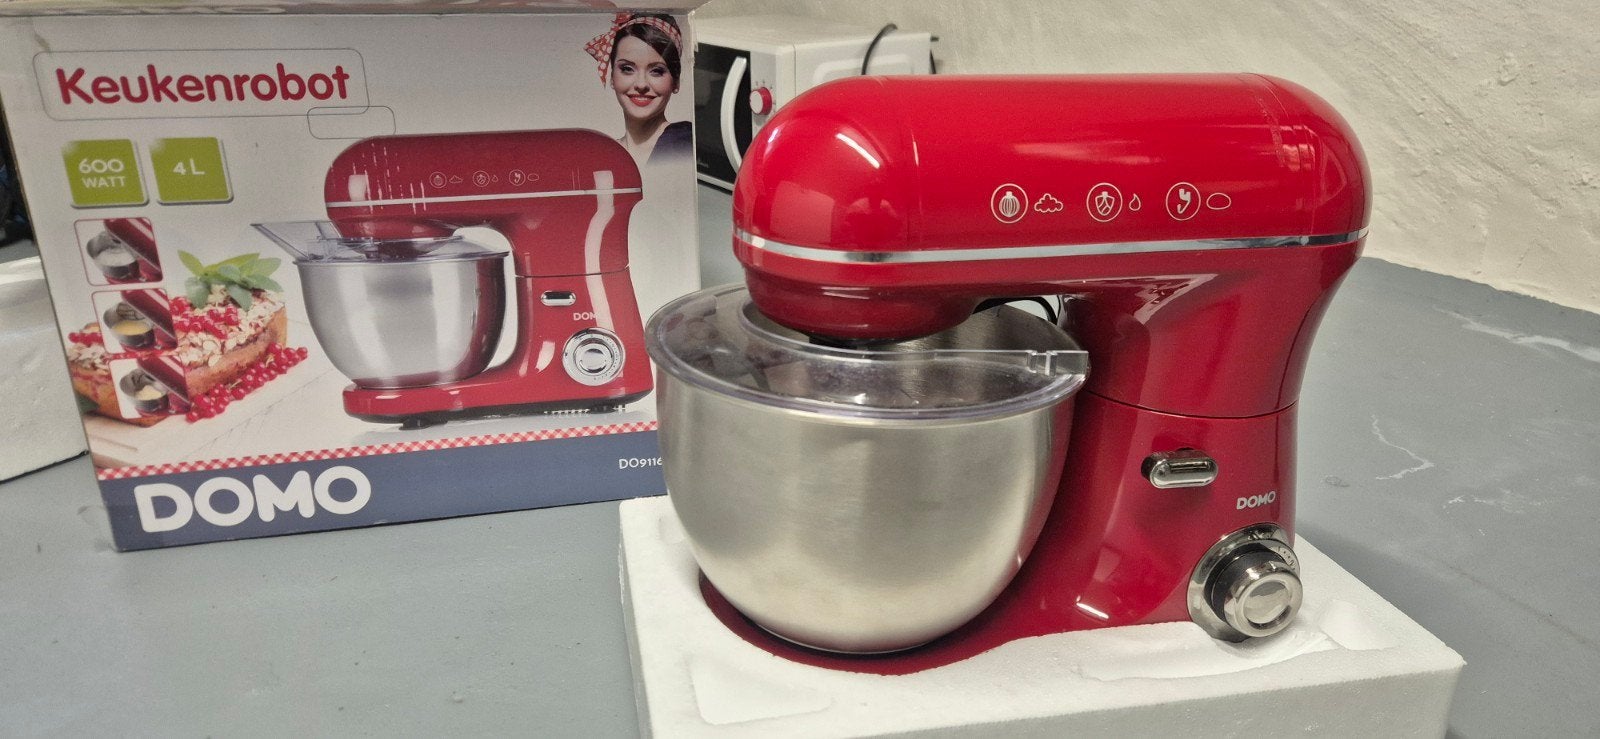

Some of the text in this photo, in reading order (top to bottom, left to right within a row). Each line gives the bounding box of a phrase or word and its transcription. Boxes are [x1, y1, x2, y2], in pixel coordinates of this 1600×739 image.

[56, 62, 350, 105] Keukenrobot
[79, 159, 124, 174] 600
[173, 158, 205, 175] 4 L
[82, 176, 126, 188] WATT
[134, 466, 371, 533] DOMO
[1236, 490, 1276, 510] DOMO
